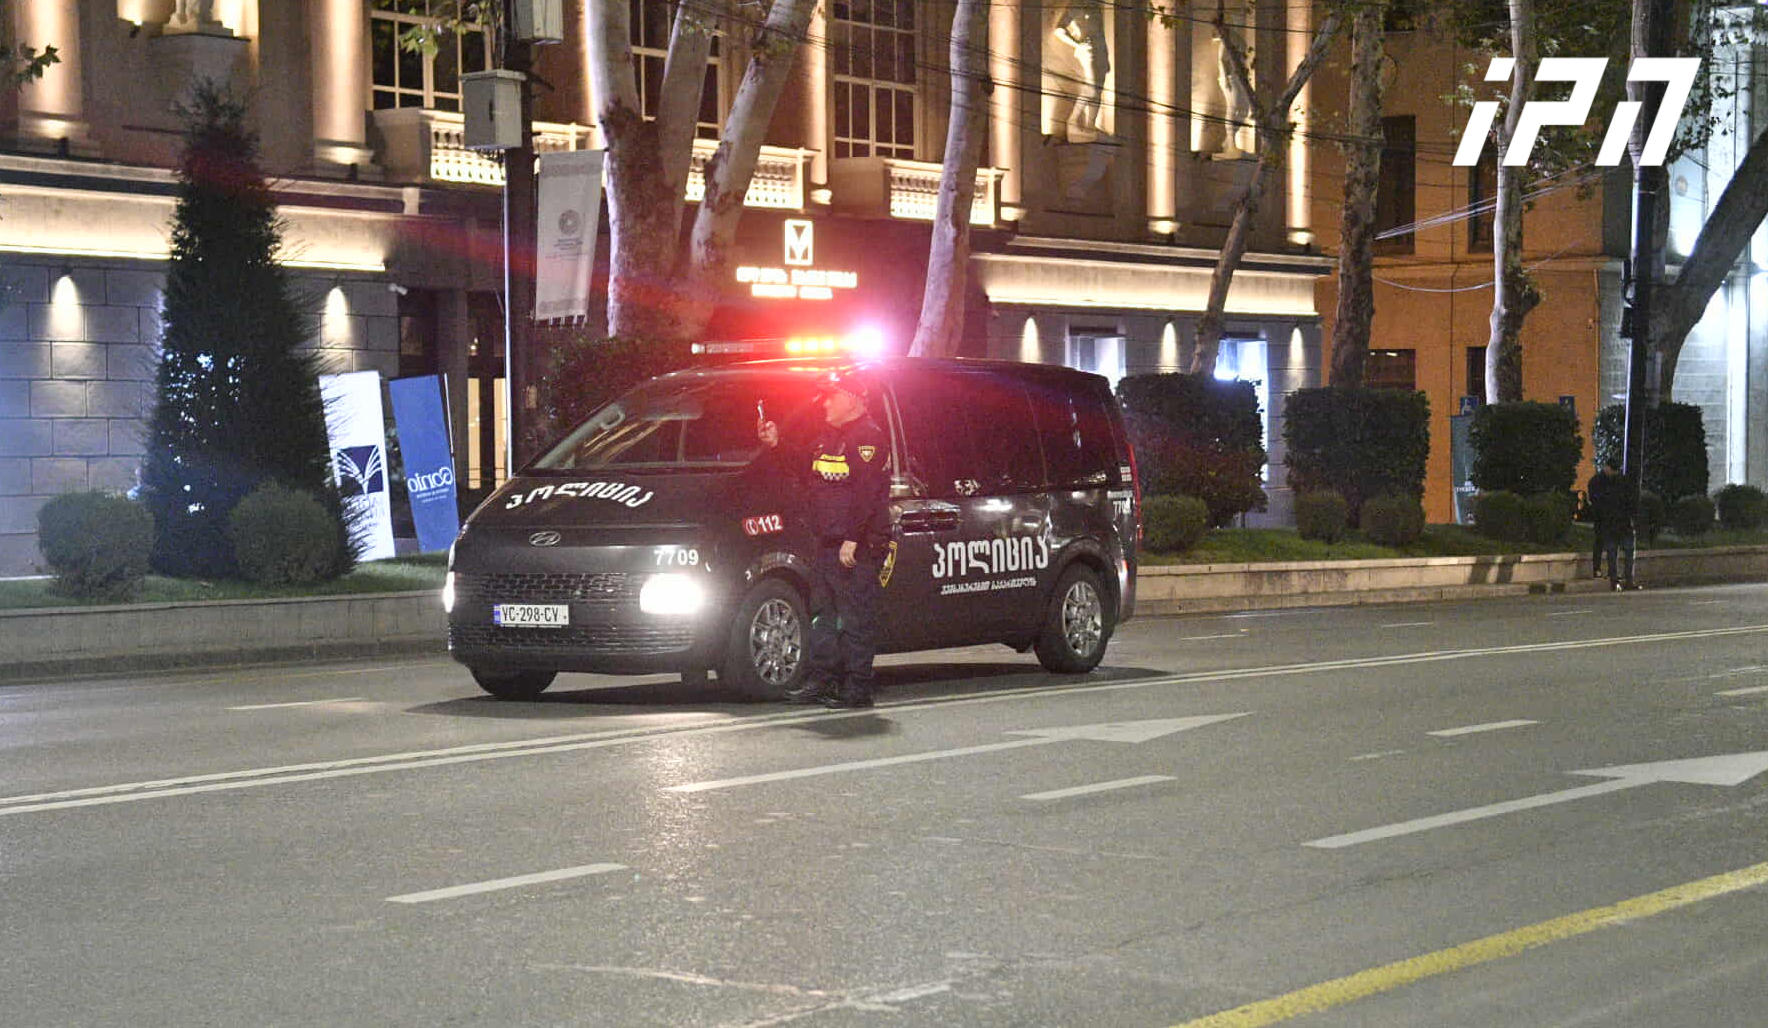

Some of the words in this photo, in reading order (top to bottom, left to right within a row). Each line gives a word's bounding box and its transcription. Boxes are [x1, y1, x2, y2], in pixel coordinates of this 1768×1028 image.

[758, 514, 783, 532] 112
[653, 548, 699, 566] 7709
[932, 535, 1049, 578] პოლიცია
